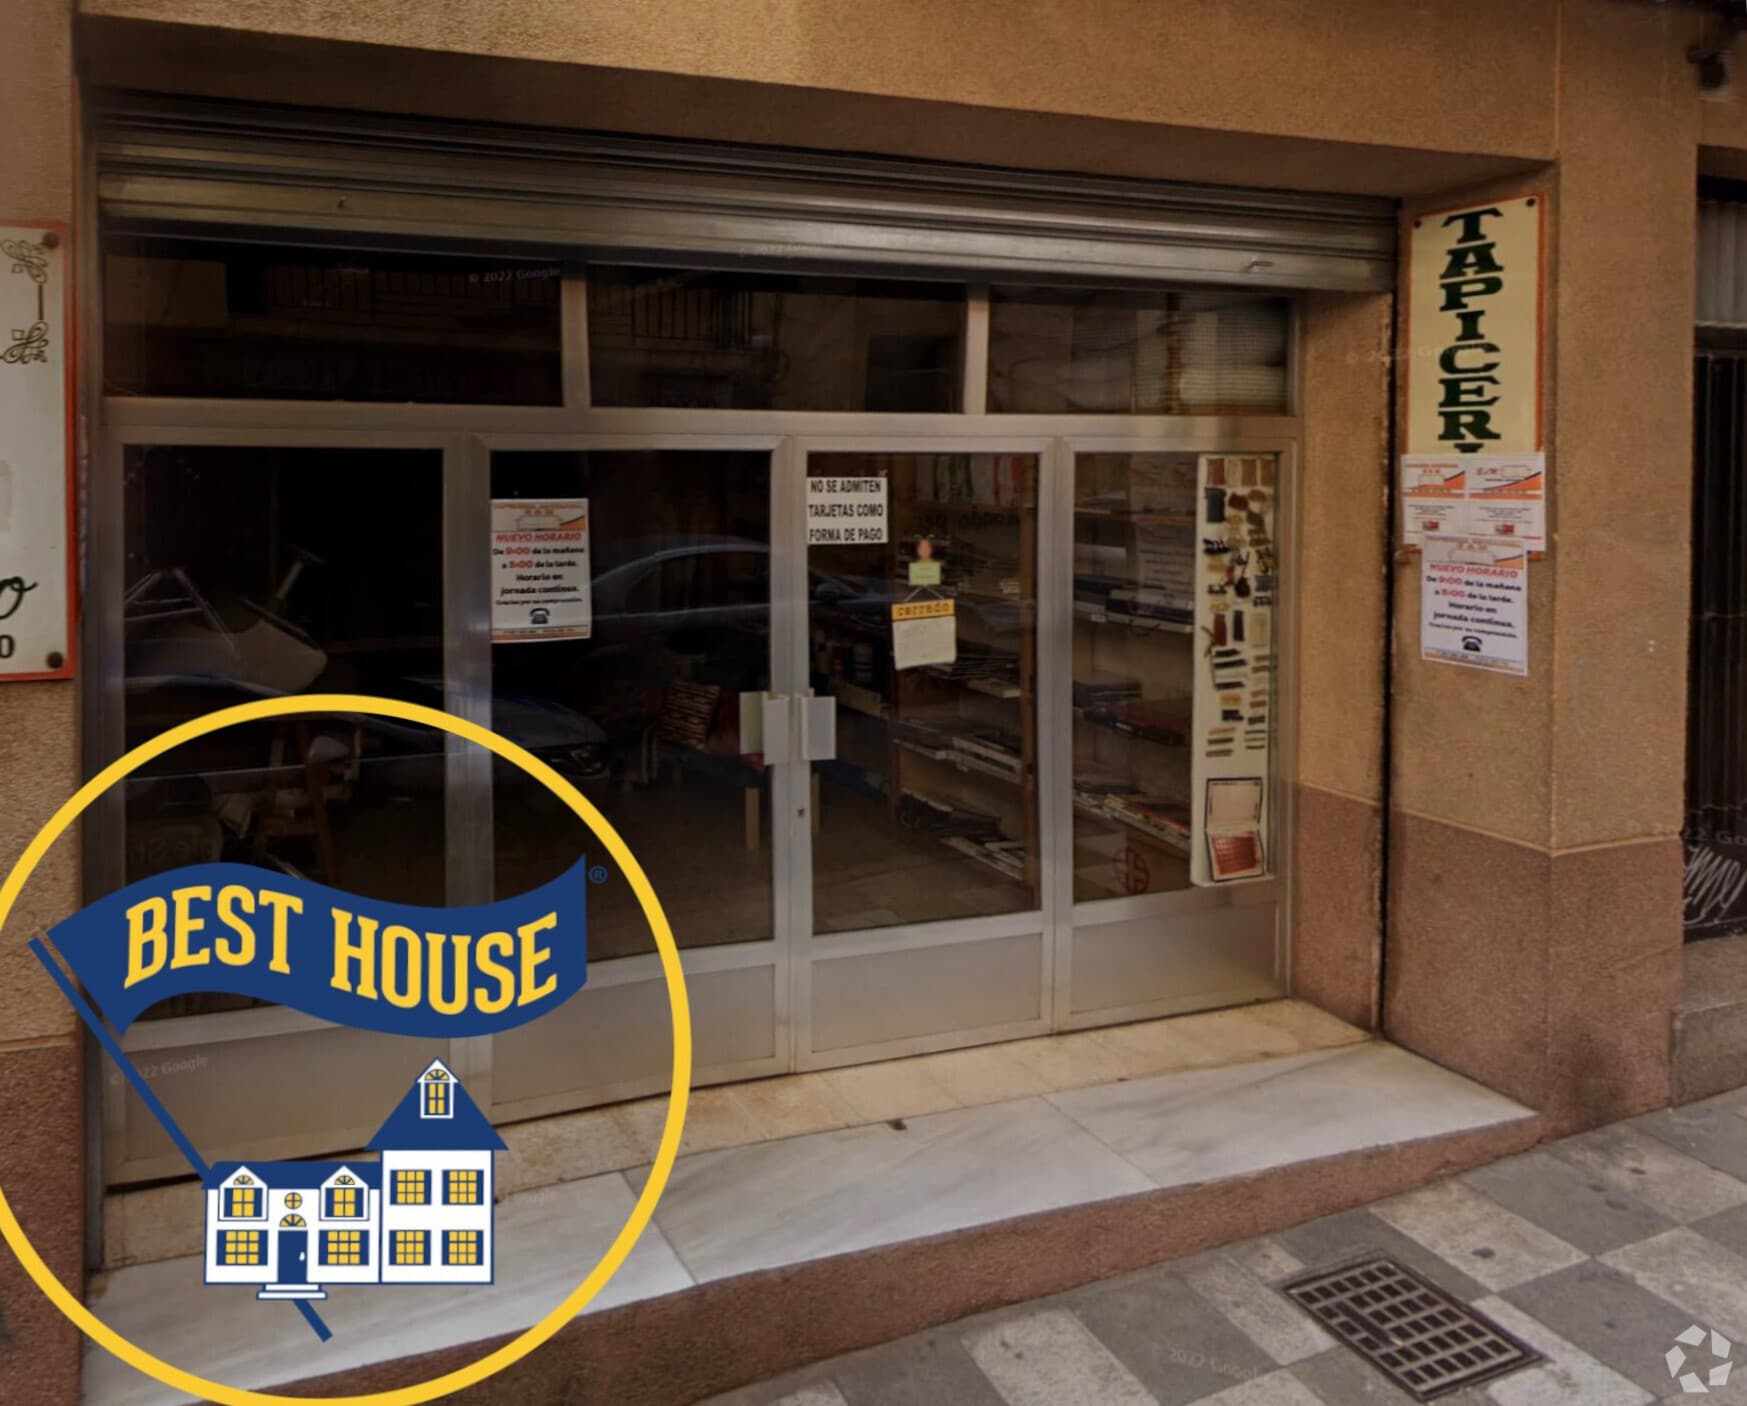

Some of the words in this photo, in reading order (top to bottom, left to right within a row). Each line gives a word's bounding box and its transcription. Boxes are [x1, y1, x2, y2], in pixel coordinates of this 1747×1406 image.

[810, 479, 824, 493] NO
[826, 479, 838, 493] SE
[840, 479, 882, 493] ADMITEN
[808, 503, 855, 517] TARJETAS
[856, 503, 884, 517] COMO
[809, 528, 841, 541] FORMA
[844, 528, 856, 541] DE
[858, 528, 883, 541] PAGO
